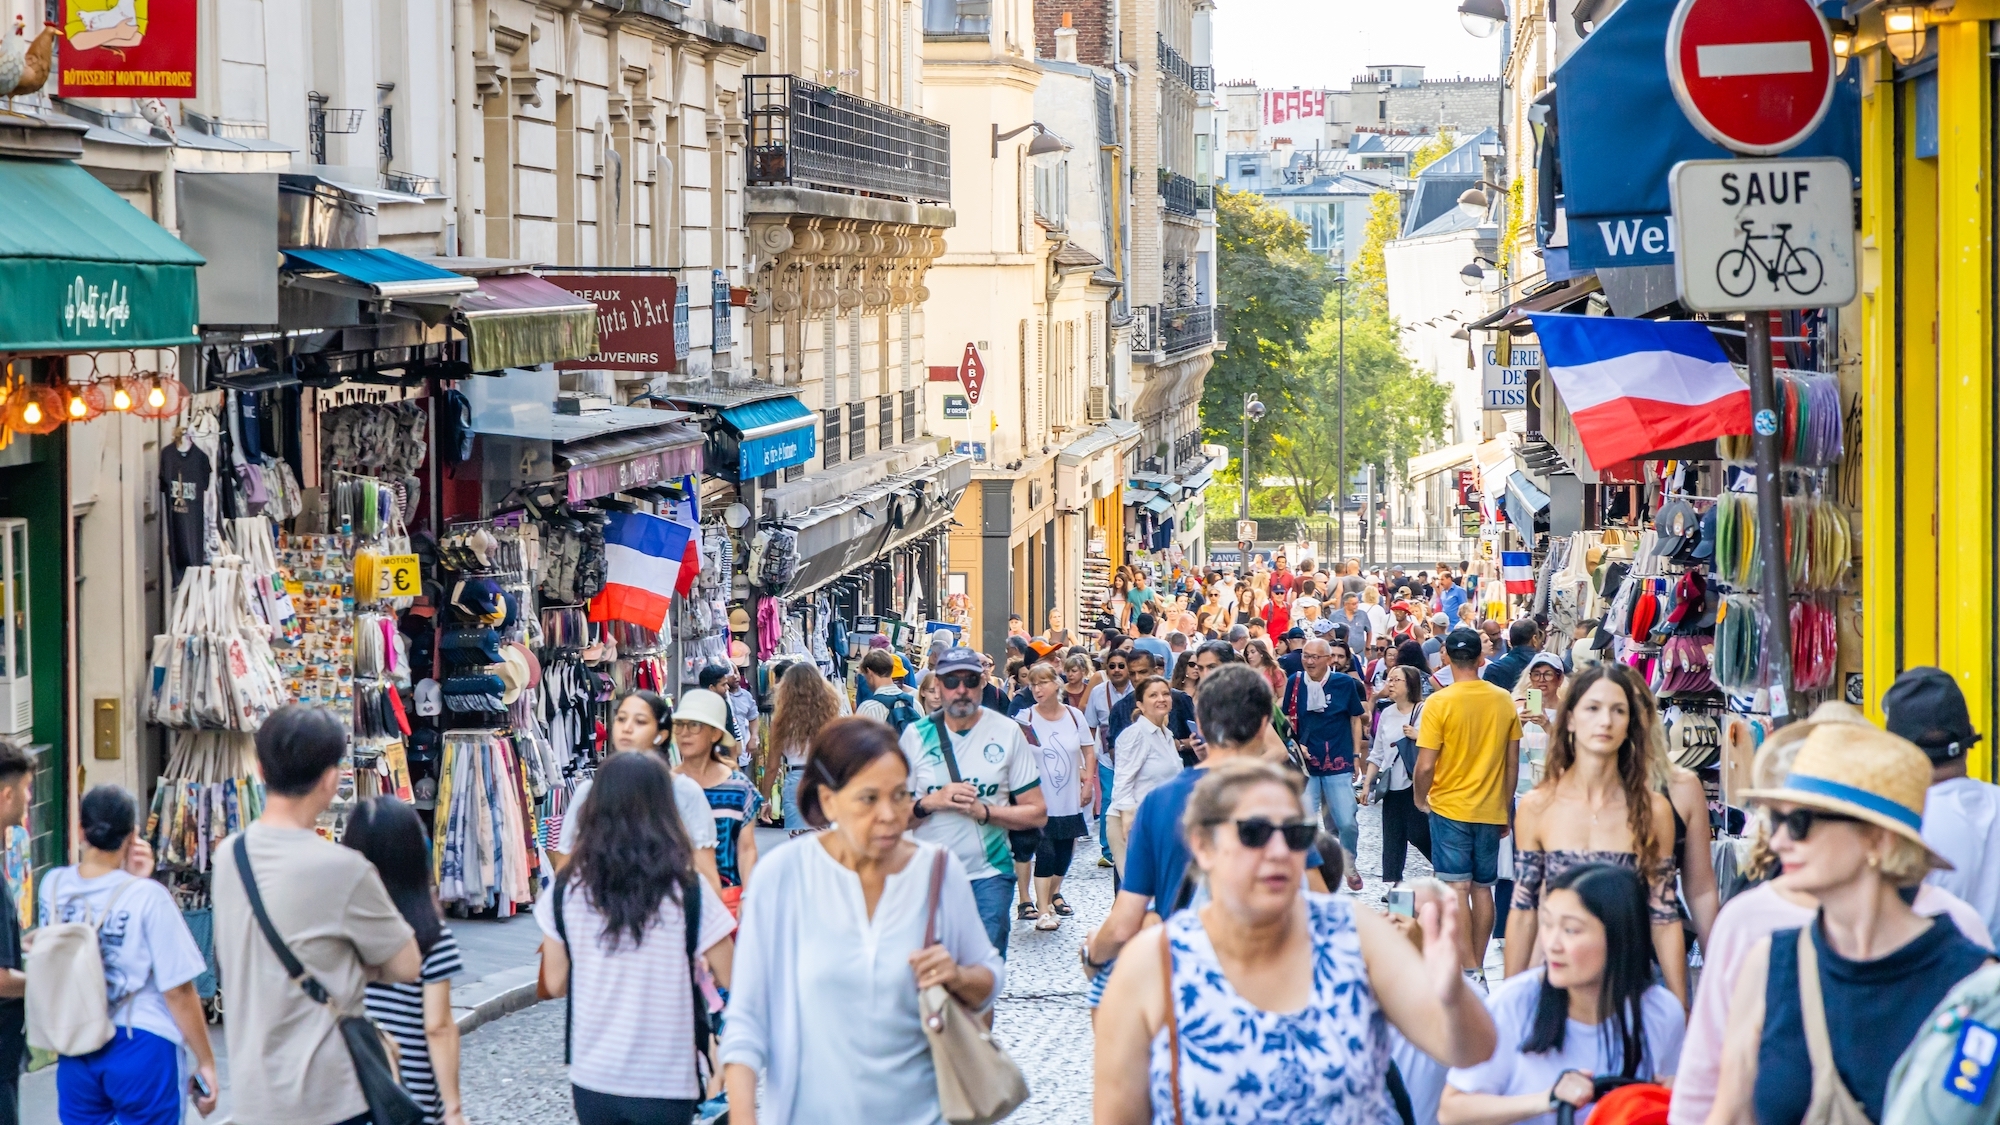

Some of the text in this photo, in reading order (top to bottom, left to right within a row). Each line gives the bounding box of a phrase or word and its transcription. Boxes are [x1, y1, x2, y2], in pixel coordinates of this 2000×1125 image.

[63, 68, 192, 88] RÔTISSERIE MONTMARTROISE
[1721, 171, 1810, 206] SAUF
[568, 289, 621, 301] DEAUX
[631, 296, 670, 328] d'Art
[1487, 350, 1540, 366] GERIE
[966, 346, 978, 400] TABAC
[1488, 390, 1527, 405] TISS
[381, 557, 416, 565] MOTION
[1216, 553, 1253, 562] ANVES
